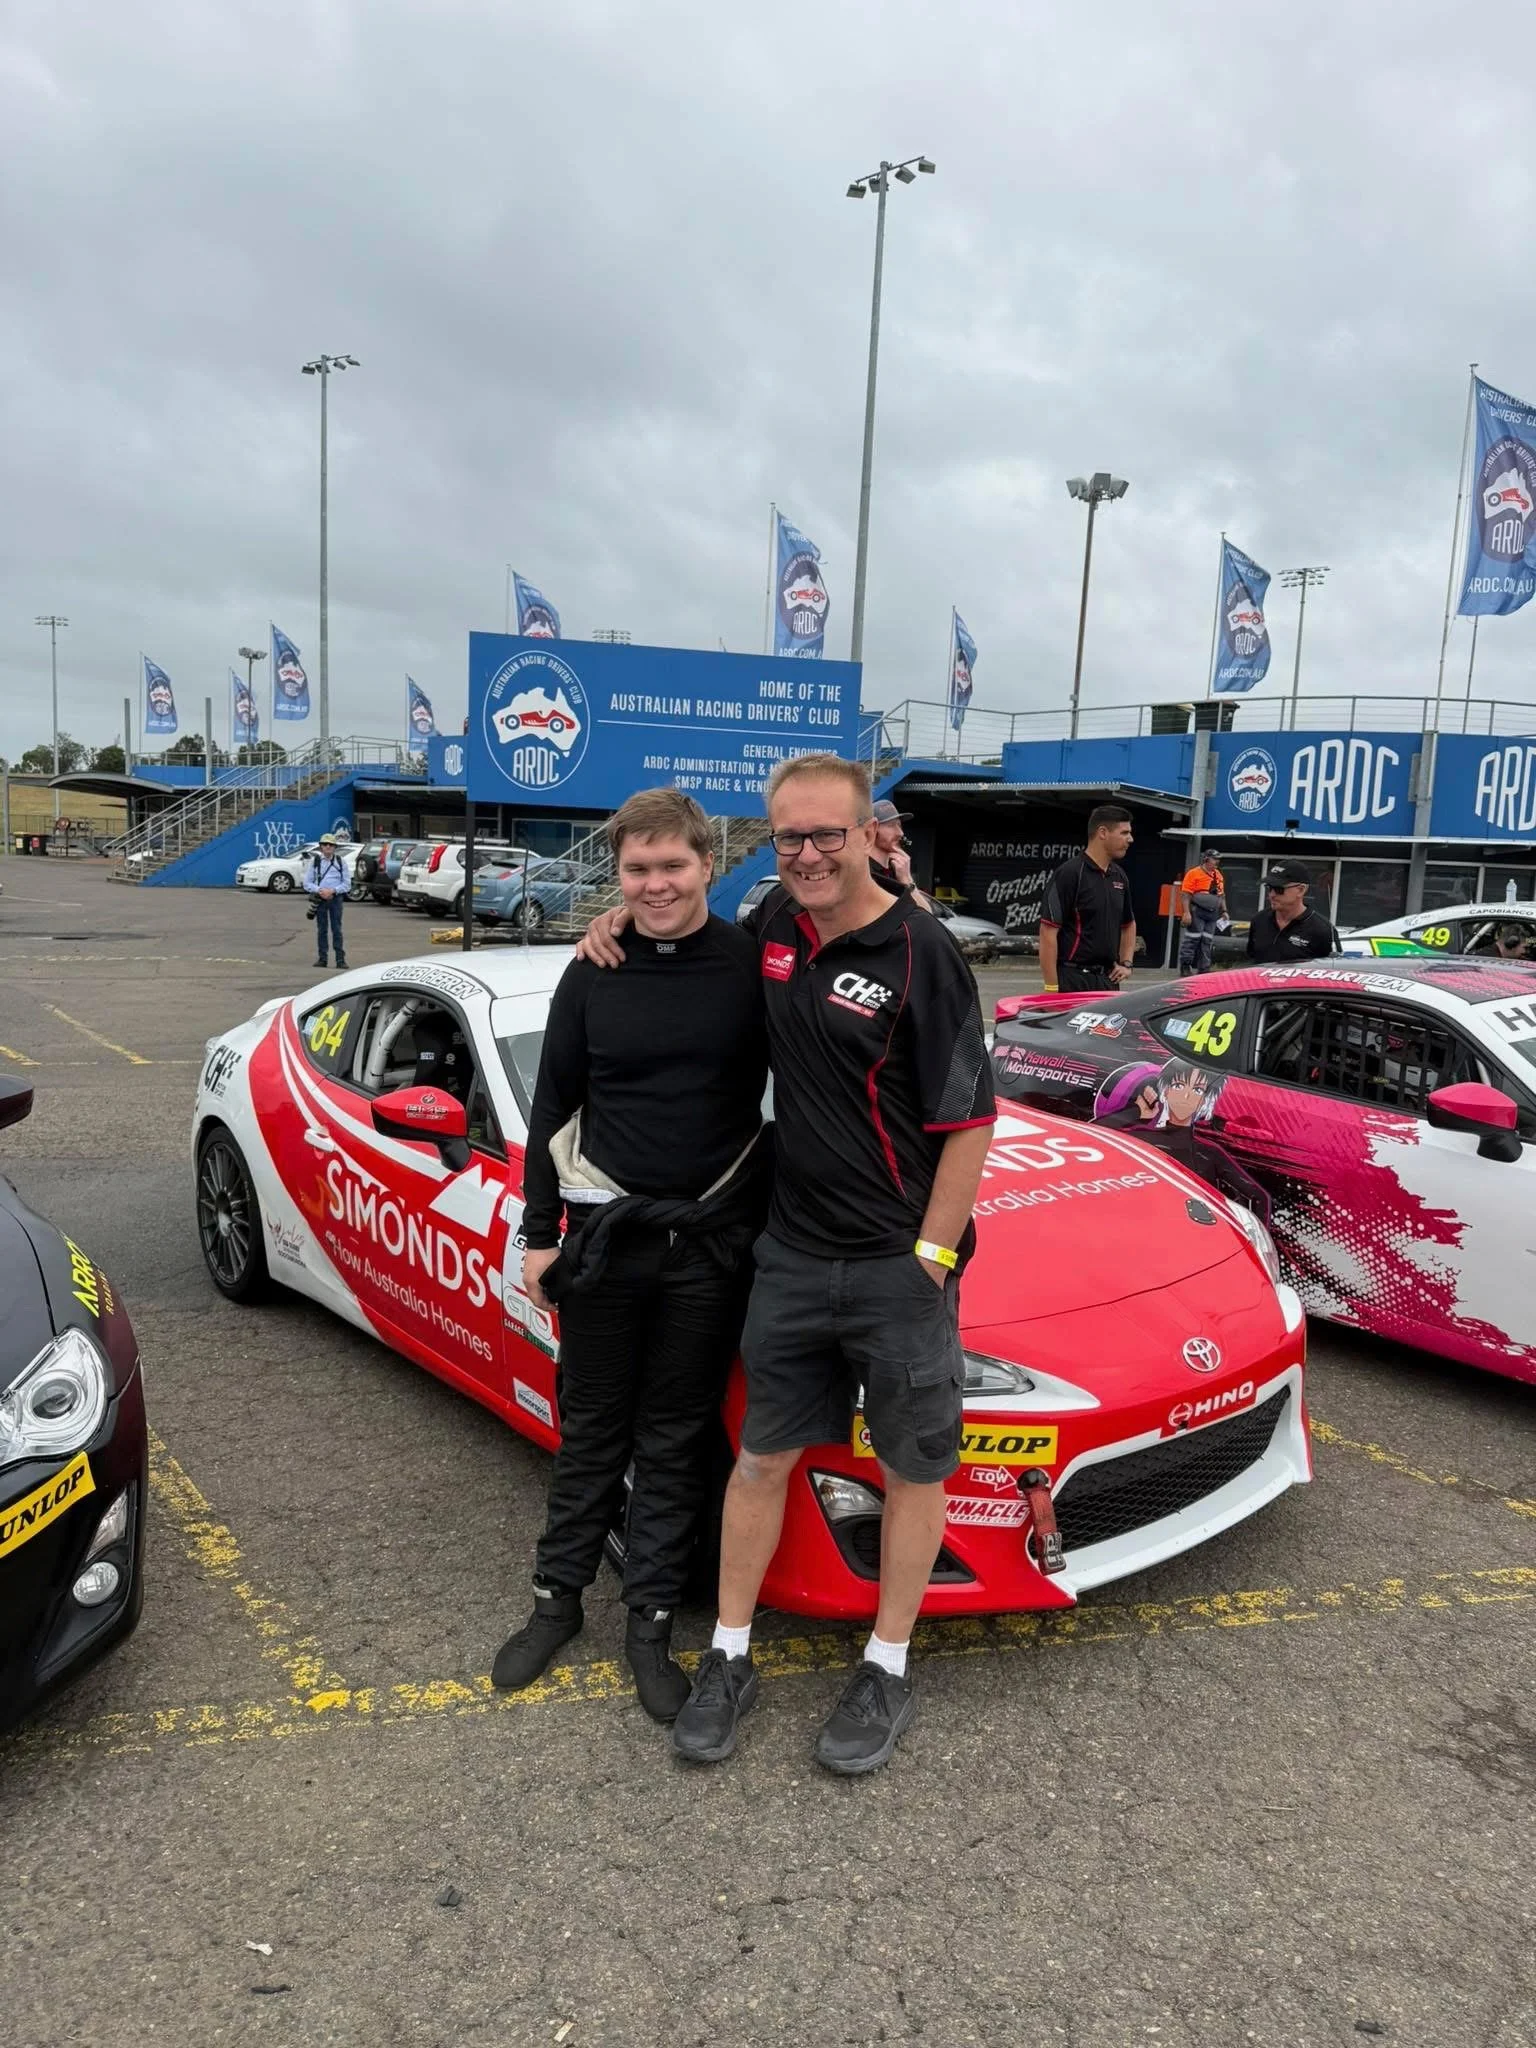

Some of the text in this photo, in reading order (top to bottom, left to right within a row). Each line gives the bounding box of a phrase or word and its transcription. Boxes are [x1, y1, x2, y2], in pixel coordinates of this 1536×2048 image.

[792, 610, 818, 635] ARDC
[492, 662, 521, 700] AUSTRALIAN
[519, 655, 547, 667] RACING
[568, 684, 583, 705] CLUB
[759, 680, 842, 703] HOME OF THE
[610, 693, 841, 726] AUSTRALIAN RACING DRIVERS' CLUB
[743, 744, 785, 760] GENERAL
[512, 746, 560, 786] ARDC
[643, 755, 671, 769] ARDC
[673, 759, 756, 776] ADMINISTRATION
[758, 762, 767, 775] &
[675, 775, 774, 793] SMSP RACE & VENU
[1289, 738, 1400, 824] ARDC
[1475, 745, 1536, 832] ARD
[1239, 791, 1262, 810] ARDC
[254, 832, 306, 851] LOVE
[264, 821, 294, 836] WE
[970, 842, 1085, 859] ARDC RACE OFFIC
[1469, 908, 1534, 916] CAPOBIANCO
[656, 944, 677, 953] OMP
[1420, 926, 1451, 947] 49
[833, 972, 880, 1004] CH
[1492, 1003, 1536, 1031] H
[310, 1005, 351, 1057] 64
[1186, 1009, 1237, 1057] 43
[1006, 1060, 1082, 1085] Motorsports
[981, 1137, 1105, 1179] NDS
[973, 1171, 1160, 1217] tralia Homes
[327, 1159, 487, 1308] SIMONDS
[64, 1236, 100, 1318] ARRO
[364, 1258, 429, 1321] Australia
[430, 1301, 493, 1362] Homes
[1194, 1381, 1254, 1417] HINO
[959, 1433, 1051, 1455] NLOP
[975, 1471, 1009, 1484] TOW
[0, 1465, 85, 1545] UNLOP
[946, 1499, 1031, 1518] NNACLE
